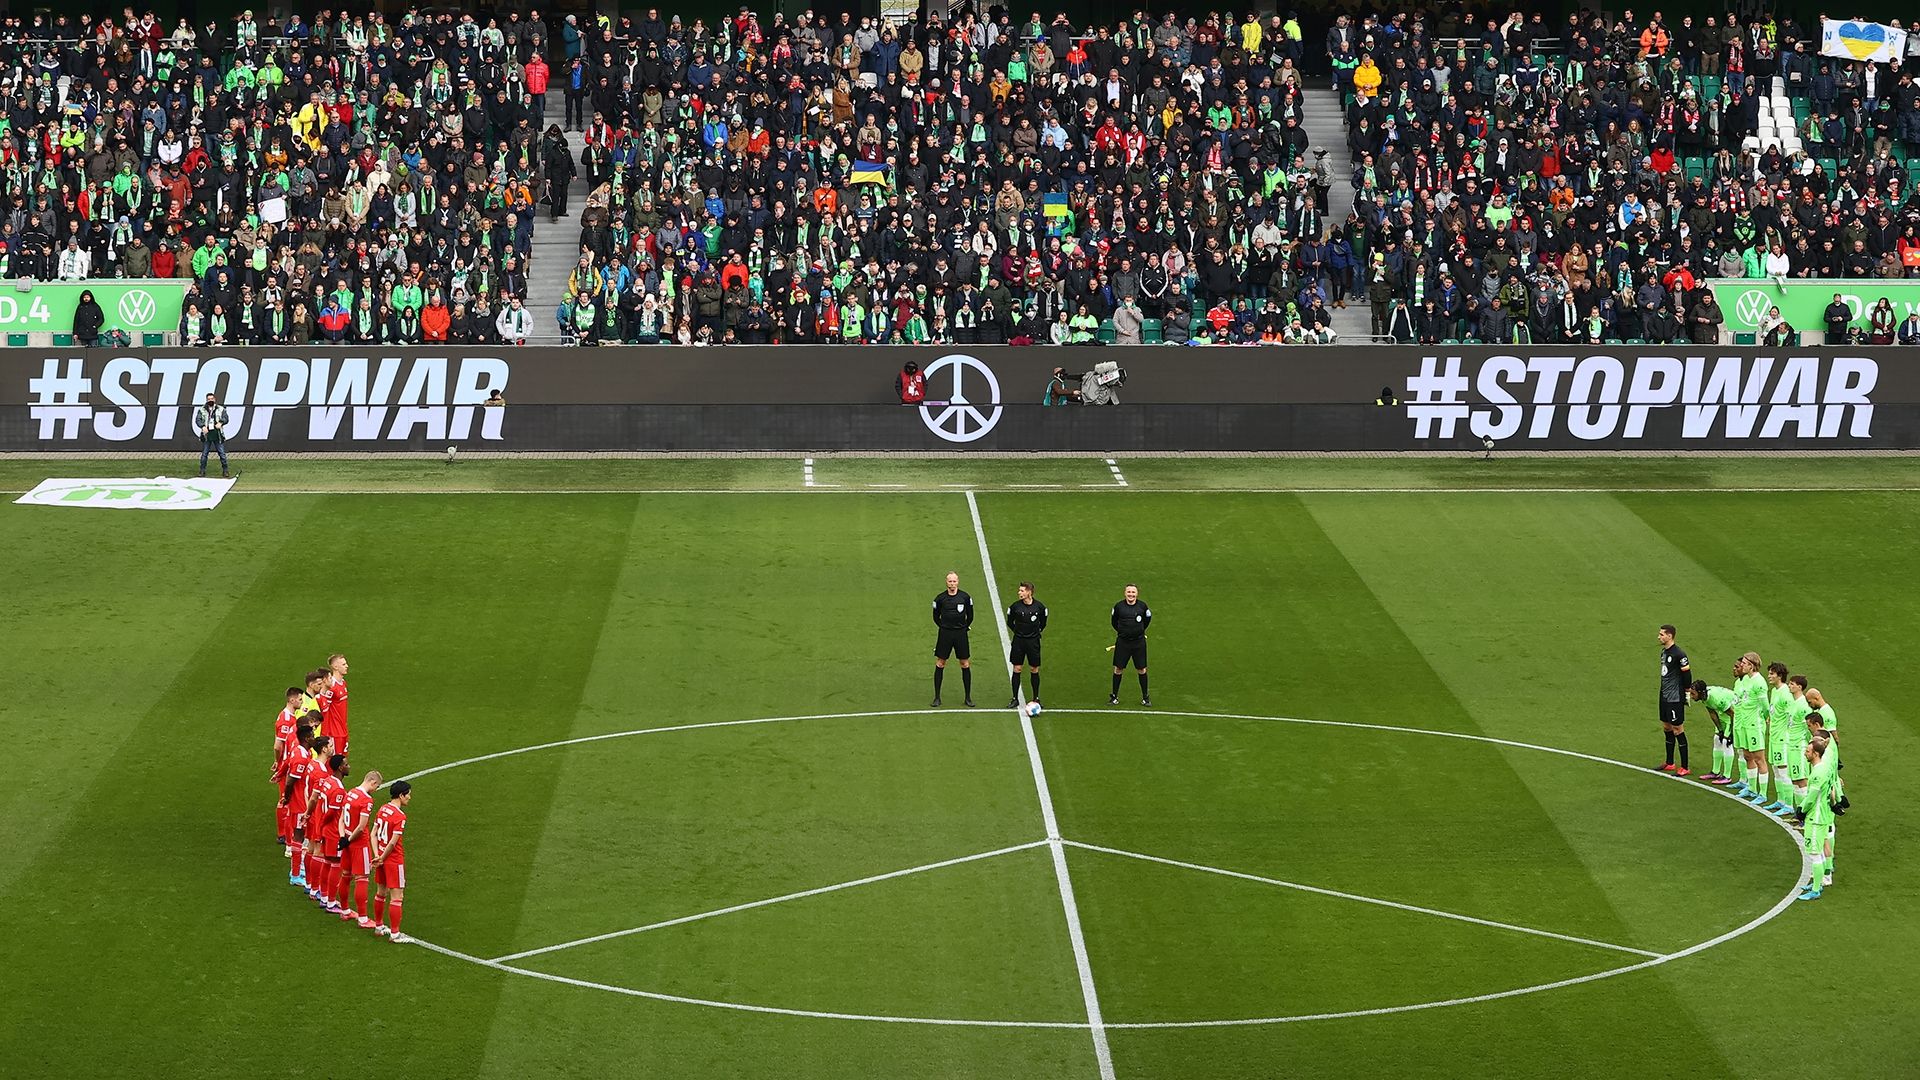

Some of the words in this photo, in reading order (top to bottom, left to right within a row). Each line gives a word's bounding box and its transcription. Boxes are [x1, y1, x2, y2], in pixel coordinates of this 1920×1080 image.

[28, 357, 510, 441] #STOPWAR
[1404, 355, 1879, 440] #STOPWAR
[1751, 737, 1757, 746] 3
[1773, 751, 1782, 761] 23
[1792, 765, 1800, 775] 21
